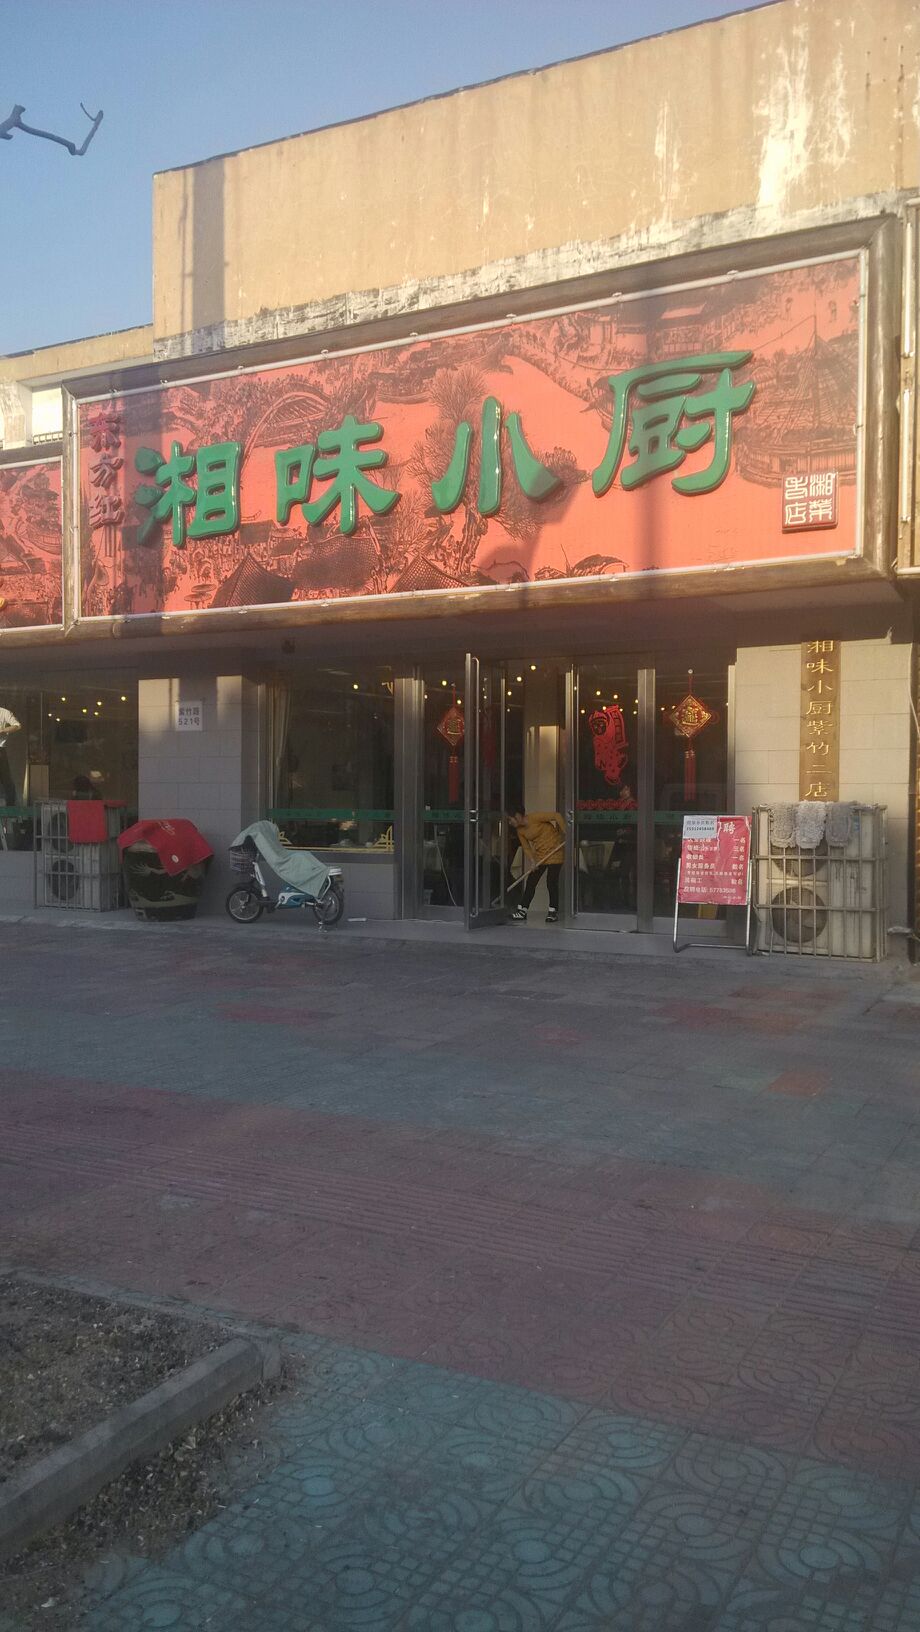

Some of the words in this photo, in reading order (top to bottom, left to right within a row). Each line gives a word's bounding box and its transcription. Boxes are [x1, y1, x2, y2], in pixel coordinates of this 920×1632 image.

[134, 350, 756, 548] 湘味小厨
[178, 716, 200, 726] 521号
[804, 639, 834, 798] 湘味小厨紫竹二店
